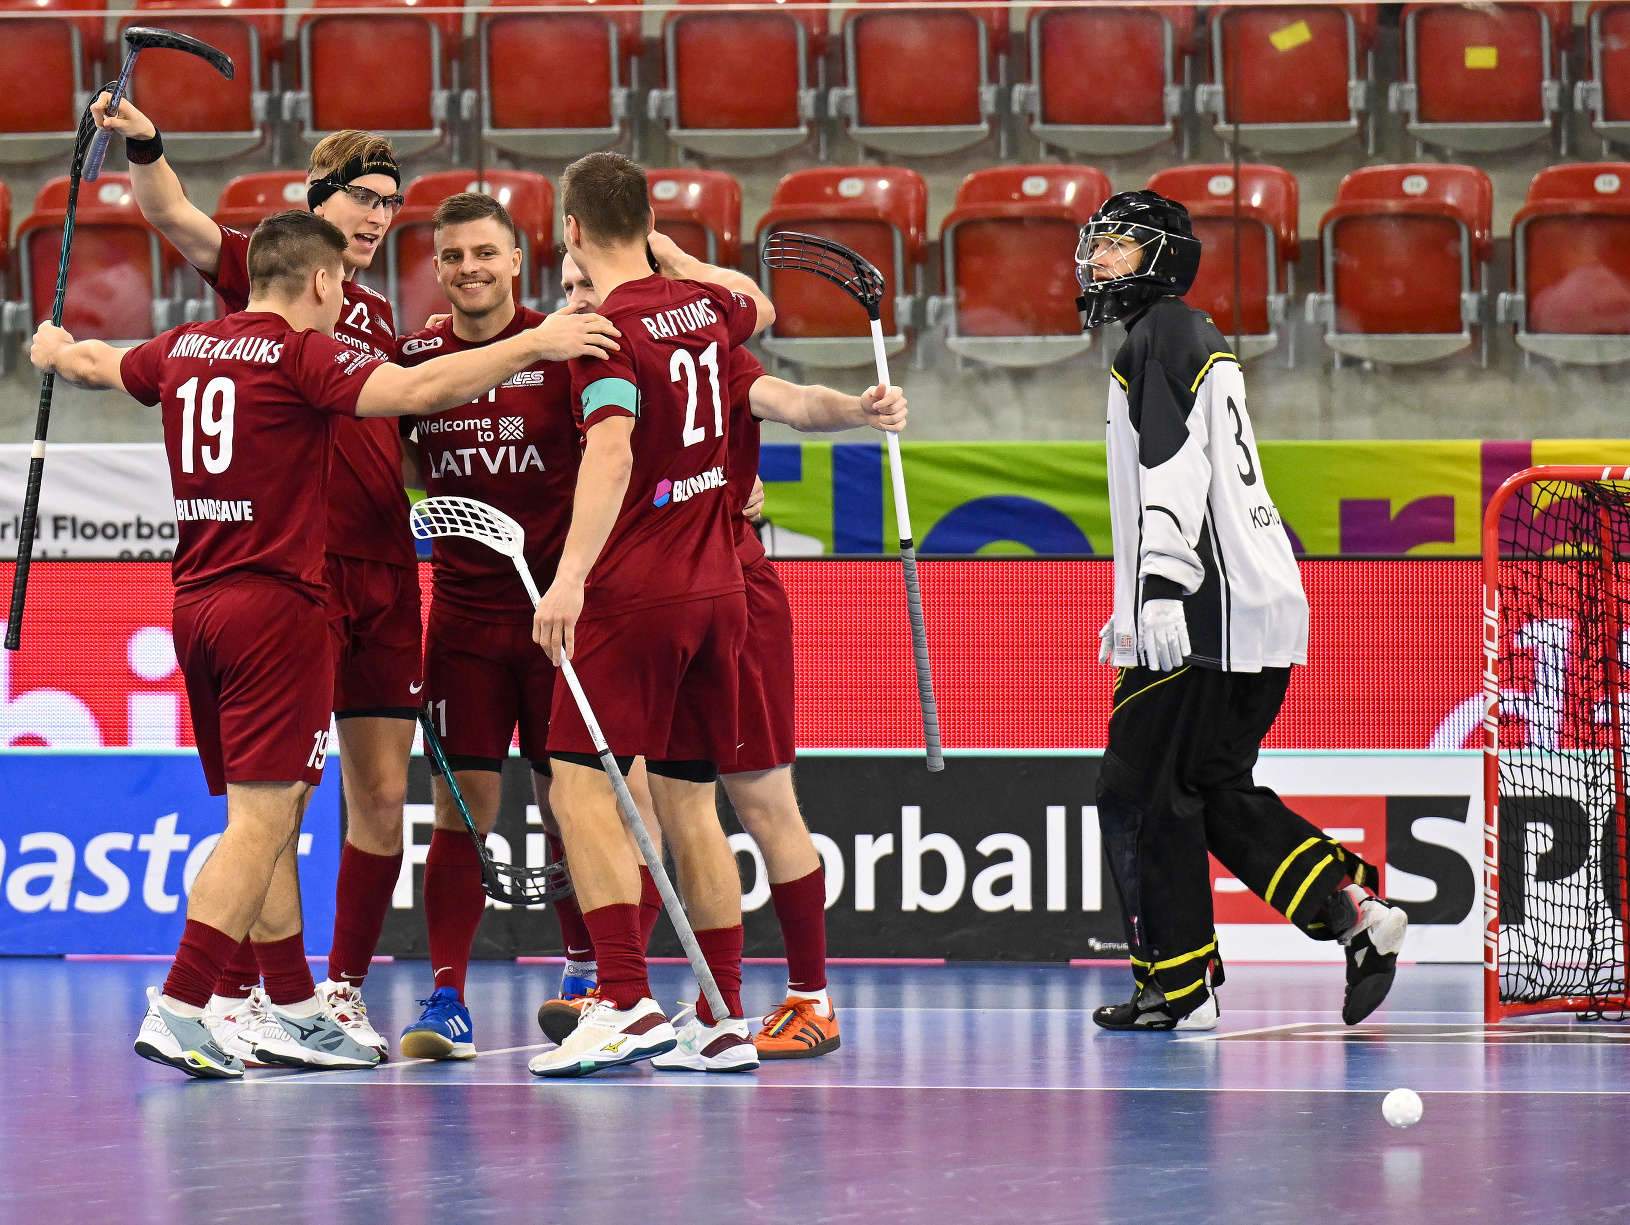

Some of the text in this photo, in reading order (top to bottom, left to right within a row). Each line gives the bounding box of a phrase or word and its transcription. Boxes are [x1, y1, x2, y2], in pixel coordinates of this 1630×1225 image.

[641, 297, 718, 340] RAITUMS
[669, 341, 724, 447] 21
[176, 376, 236, 474] 19
[418, 417, 492, 435] Welcome
[477, 430, 495, 442] to
[428, 444, 546, 479] LATVIA
[176, 498, 253, 521] BLINDSAVE
[1483, 584, 1499, 756] UNIHOC
[306, 730, 329, 770] 19
[1483, 804, 1499, 971] UNIHOC
